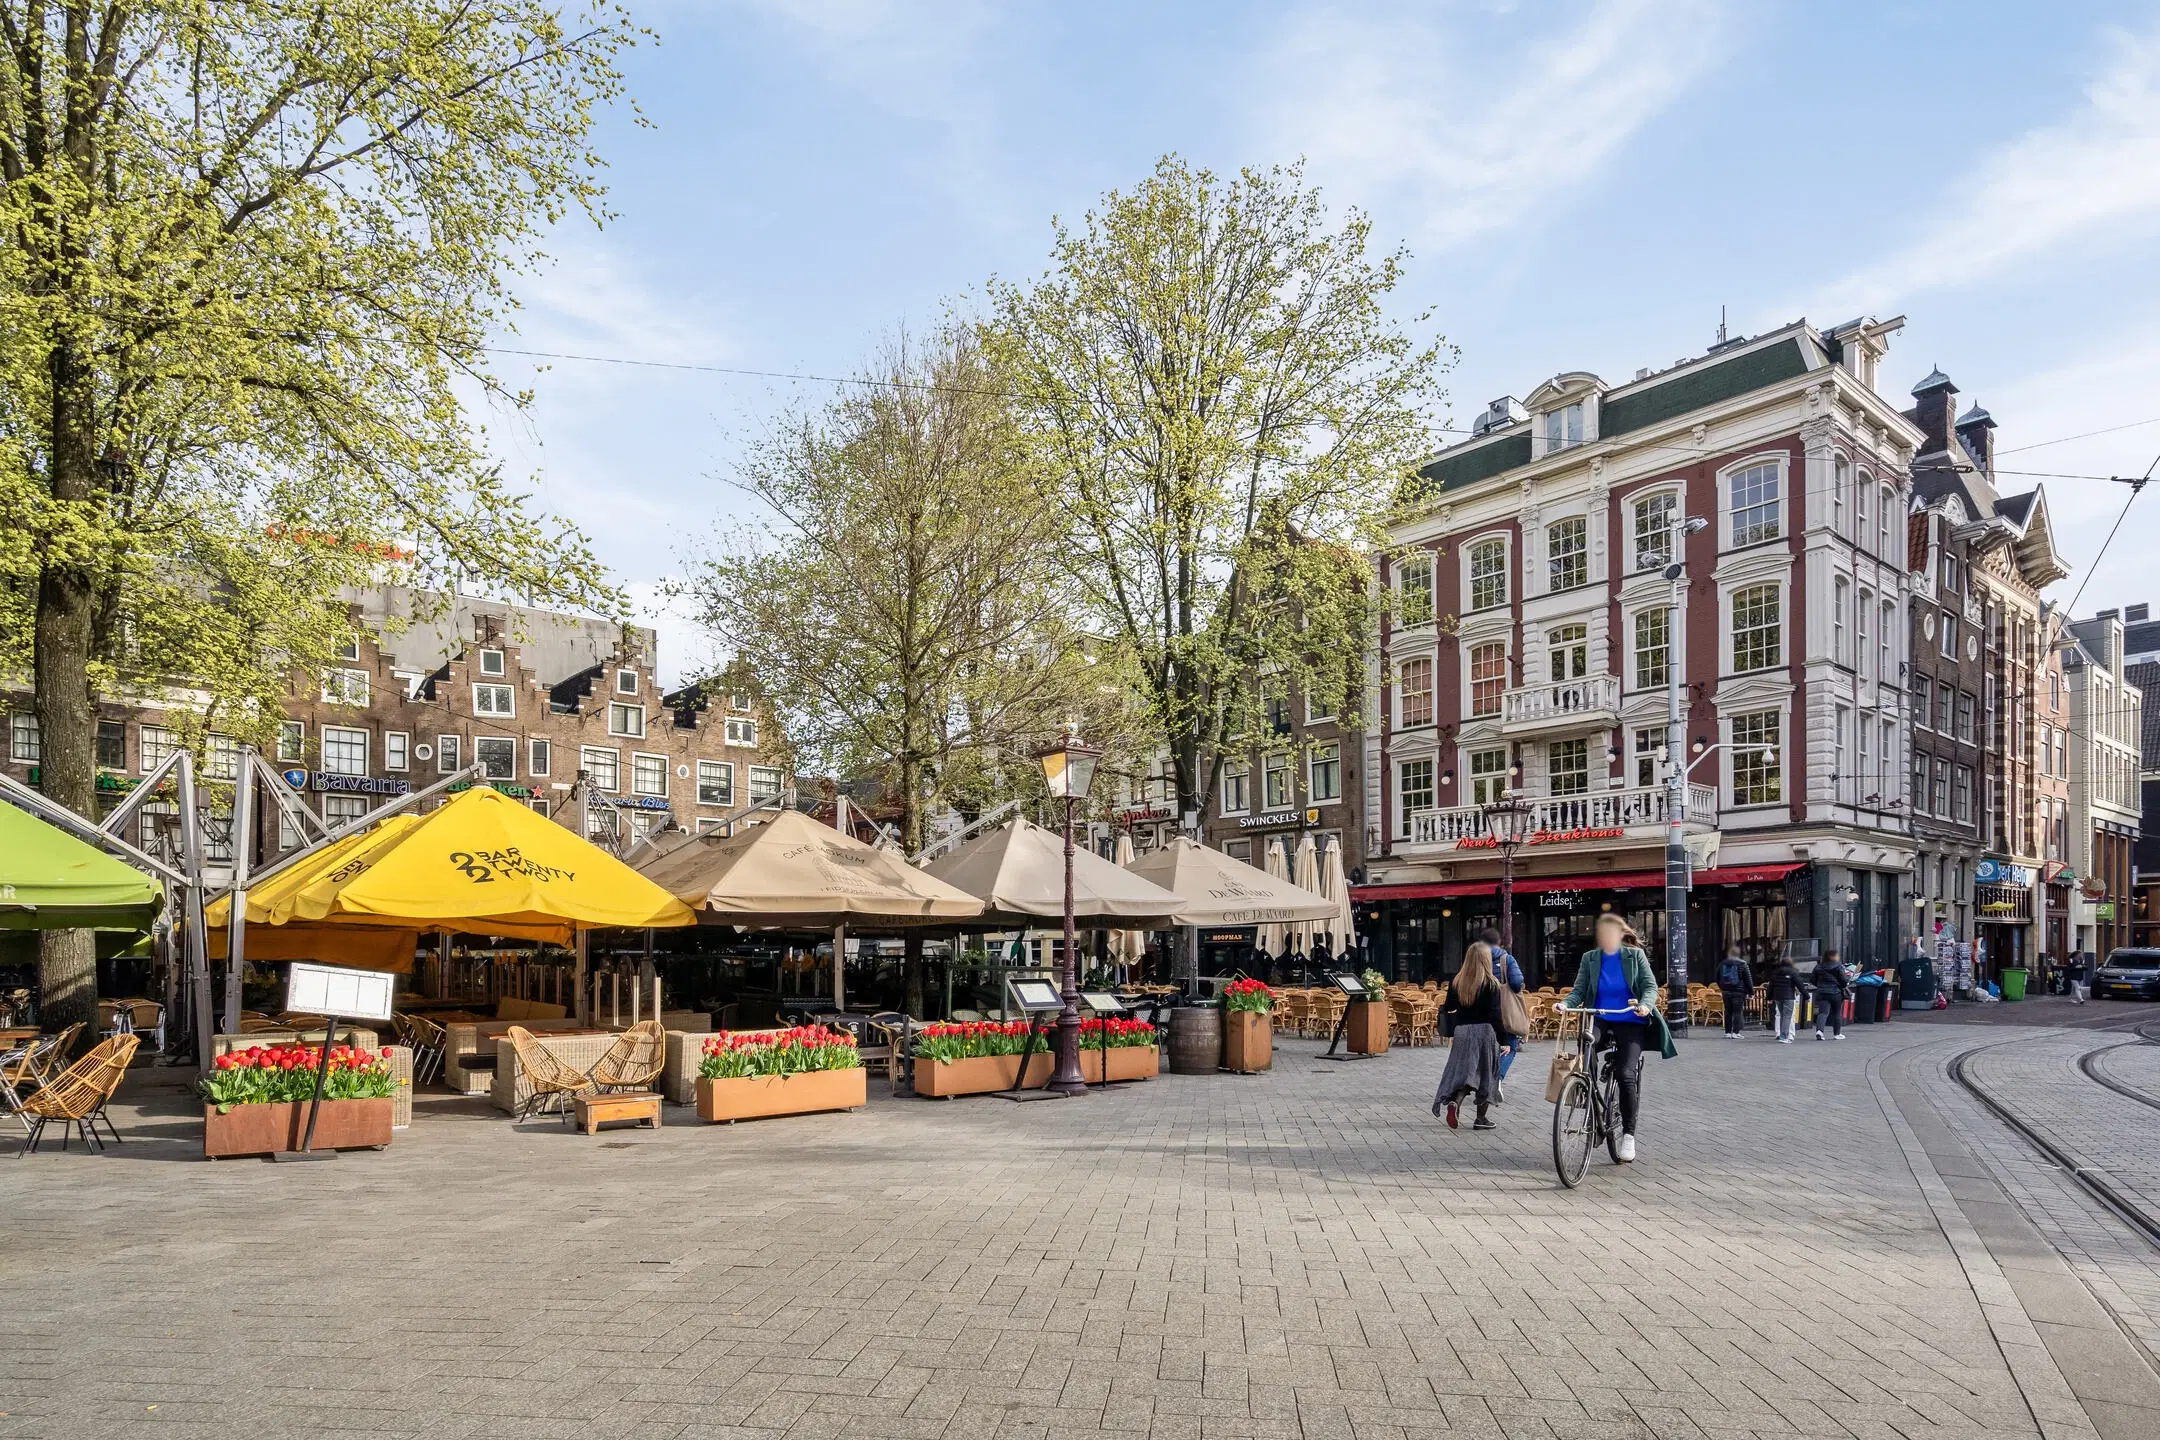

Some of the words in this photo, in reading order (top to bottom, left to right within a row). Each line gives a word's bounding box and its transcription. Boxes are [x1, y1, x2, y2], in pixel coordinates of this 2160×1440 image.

[311, 771, 411, 794] Bavaria
[1240, 811, 1300, 827] SWINCKELS'
[1528, 825, 1624, 846] Steakhouse
[474, 847, 521, 861] BAR
[487, 856, 575, 882] TWENTY
[499, 867, 549, 882] TWO
